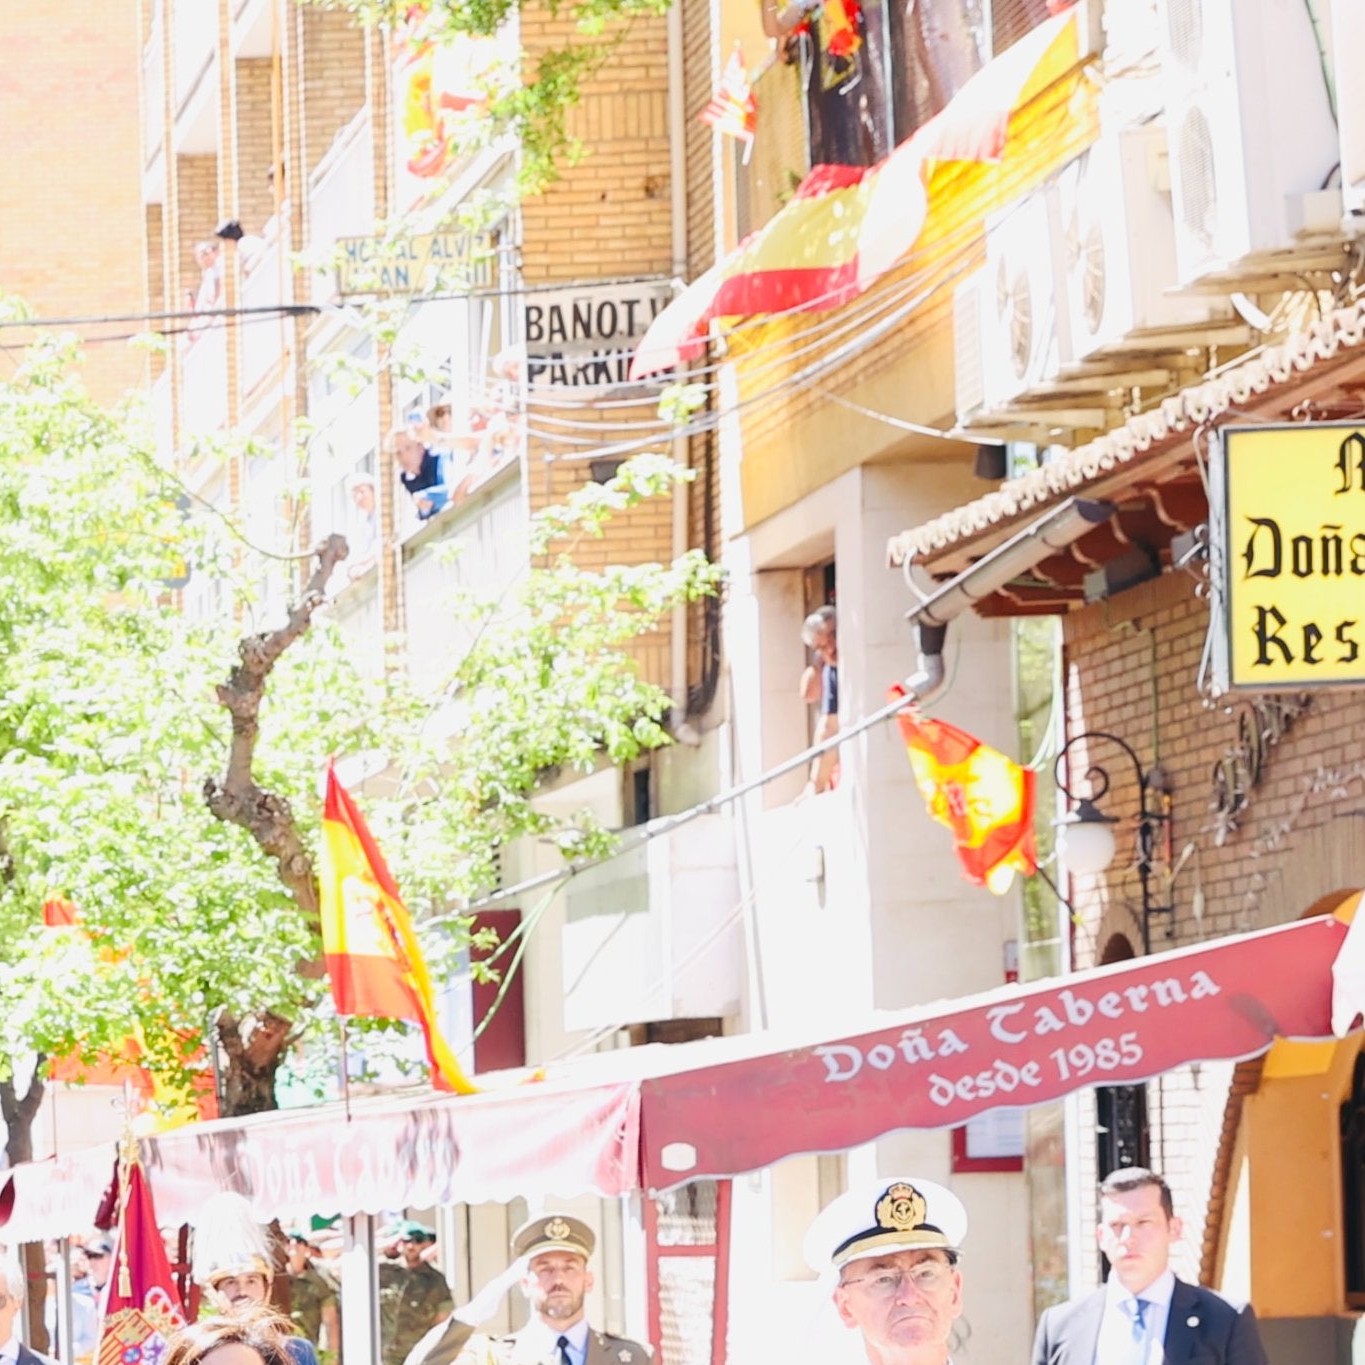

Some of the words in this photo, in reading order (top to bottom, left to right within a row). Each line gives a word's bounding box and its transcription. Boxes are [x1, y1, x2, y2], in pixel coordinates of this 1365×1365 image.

[817, 1026, 969, 1082] Doña
[987, 971, 1219, 1044] Taberna
[927, 1058, 1042, 1107] desde
[1049, 1032, 1143, 1081] 1985
